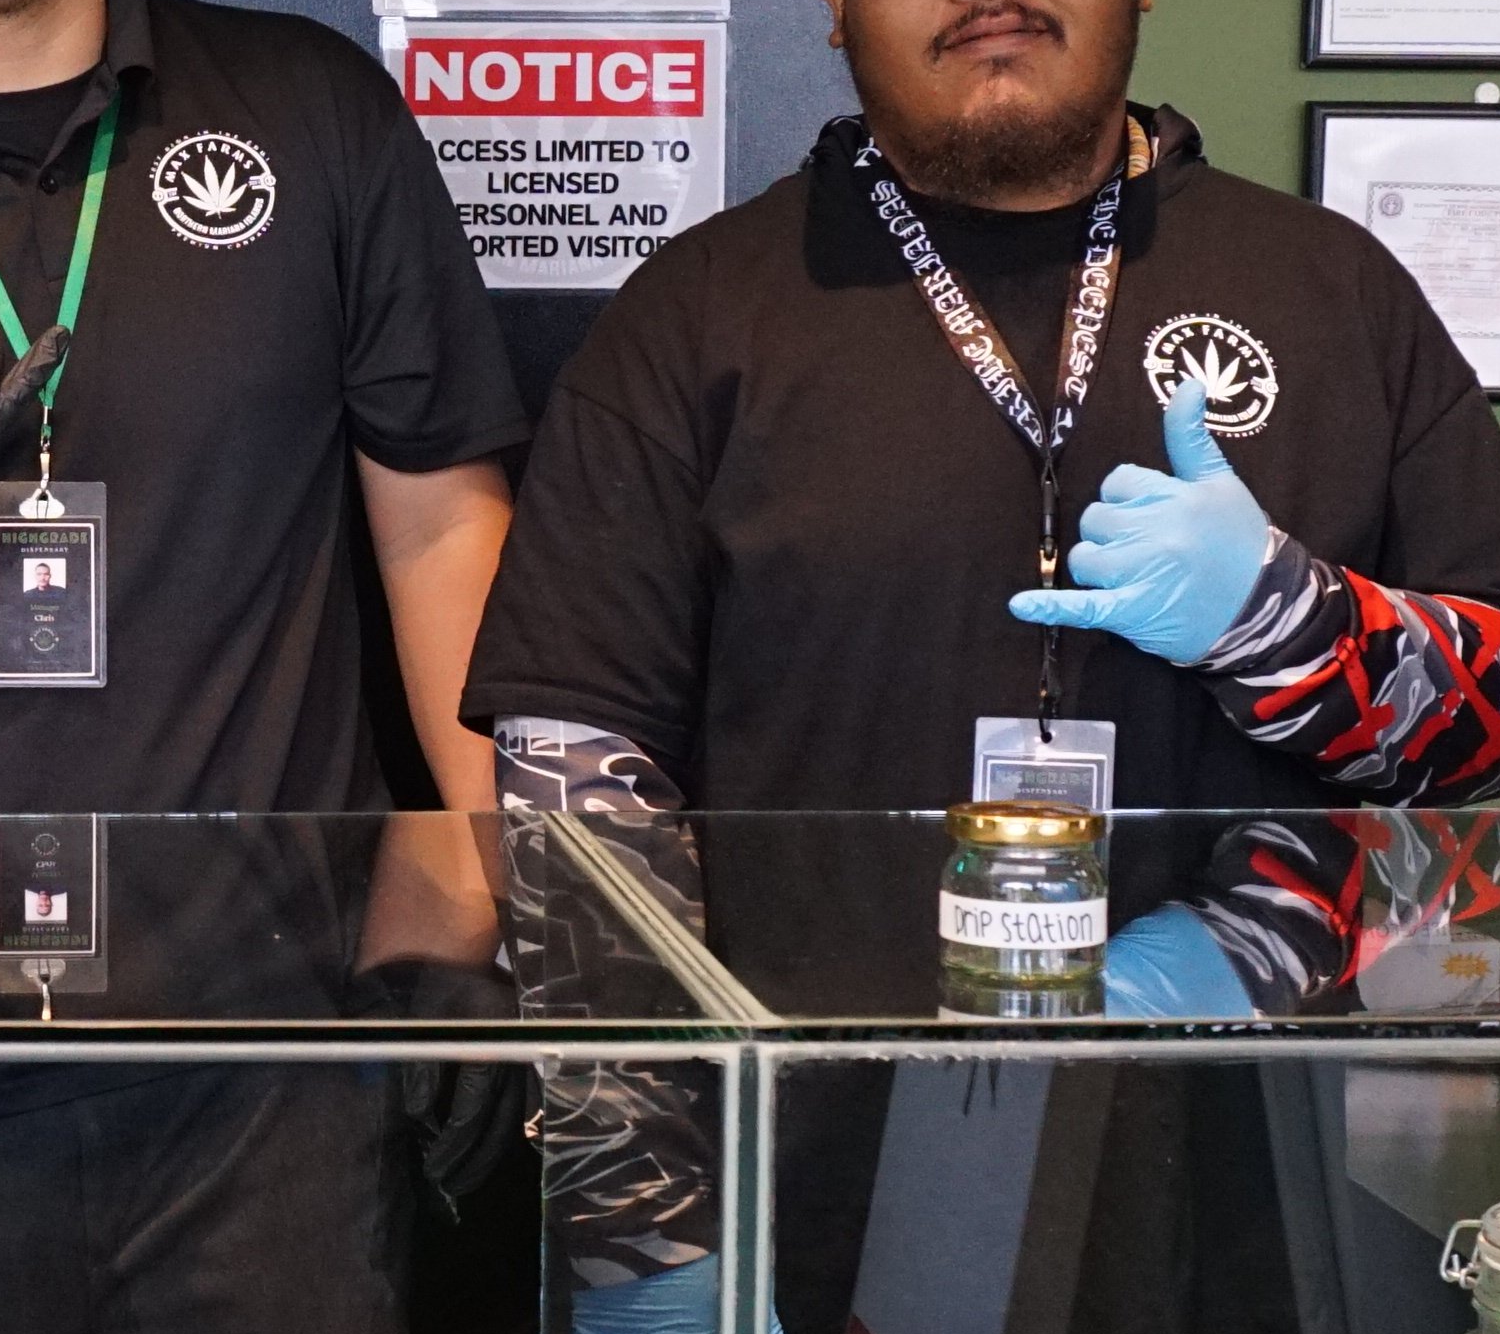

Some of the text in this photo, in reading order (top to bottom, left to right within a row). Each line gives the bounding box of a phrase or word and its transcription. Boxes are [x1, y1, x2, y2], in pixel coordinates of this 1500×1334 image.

[414, 51, 697, 103] NOTICE
[165, 141, 254, 183] MAX FARMS
[437, 140, 690, 163] CCESS LIMITED TO
[487, 172, 619, 194] LICENSED
[457, 203, 668, 226] ERSONNEL AND
[473, 235, 559, 257] ORTED
[1064, 178, 1122, 406] THE DEEPEST
[870, 179, 1044, 449] TRIBE MARIANAS
[1161, 324, 1261, 368] MAX FARMS
[1, 531, 89, 545] HIGHGRADE
[34, 614, 55, 622] Chris
